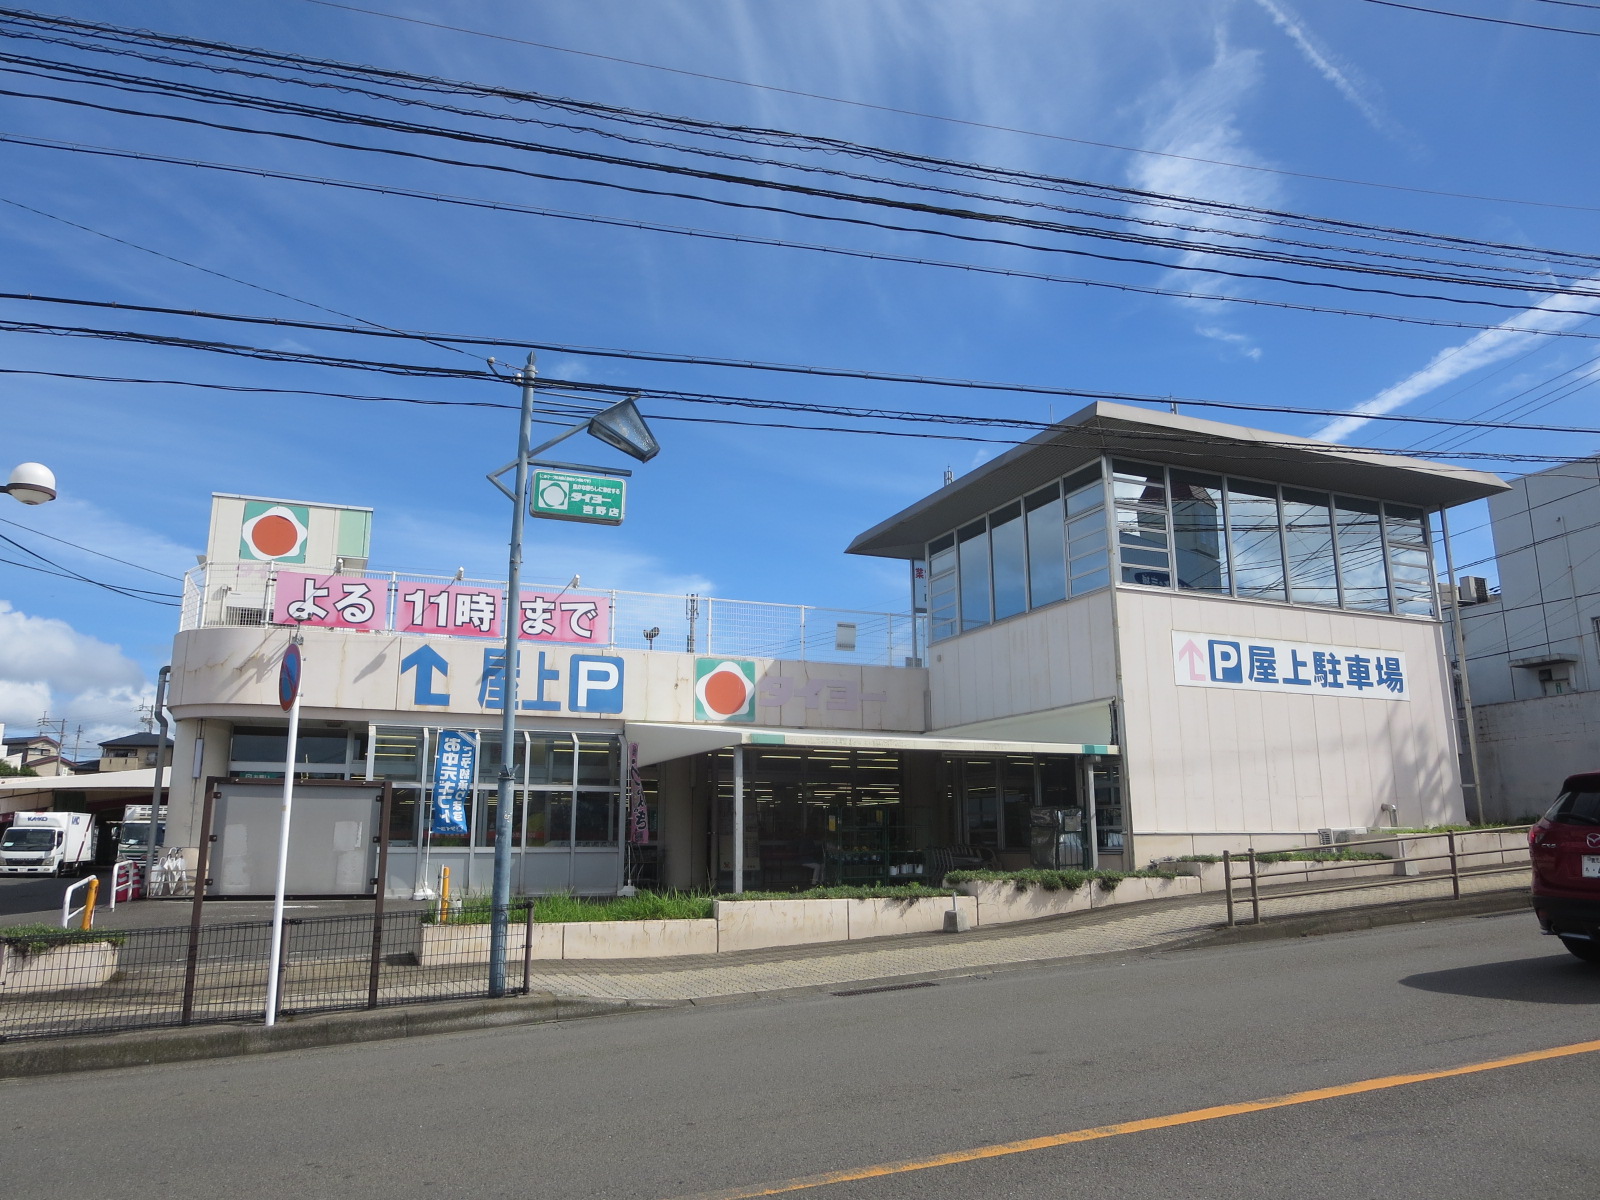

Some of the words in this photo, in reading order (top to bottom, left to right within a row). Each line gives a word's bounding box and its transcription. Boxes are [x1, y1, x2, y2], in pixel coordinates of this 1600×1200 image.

[570, 492, 612, 504] タイヨー
[287, 578, 375, 623] よる
[404, 589, 496, 633] 11時
[520, 597, 599, 639] まで
[1248, 645, 1405, 694] 屋上駐車場
[759, 676, 889, 711] タイヨー
